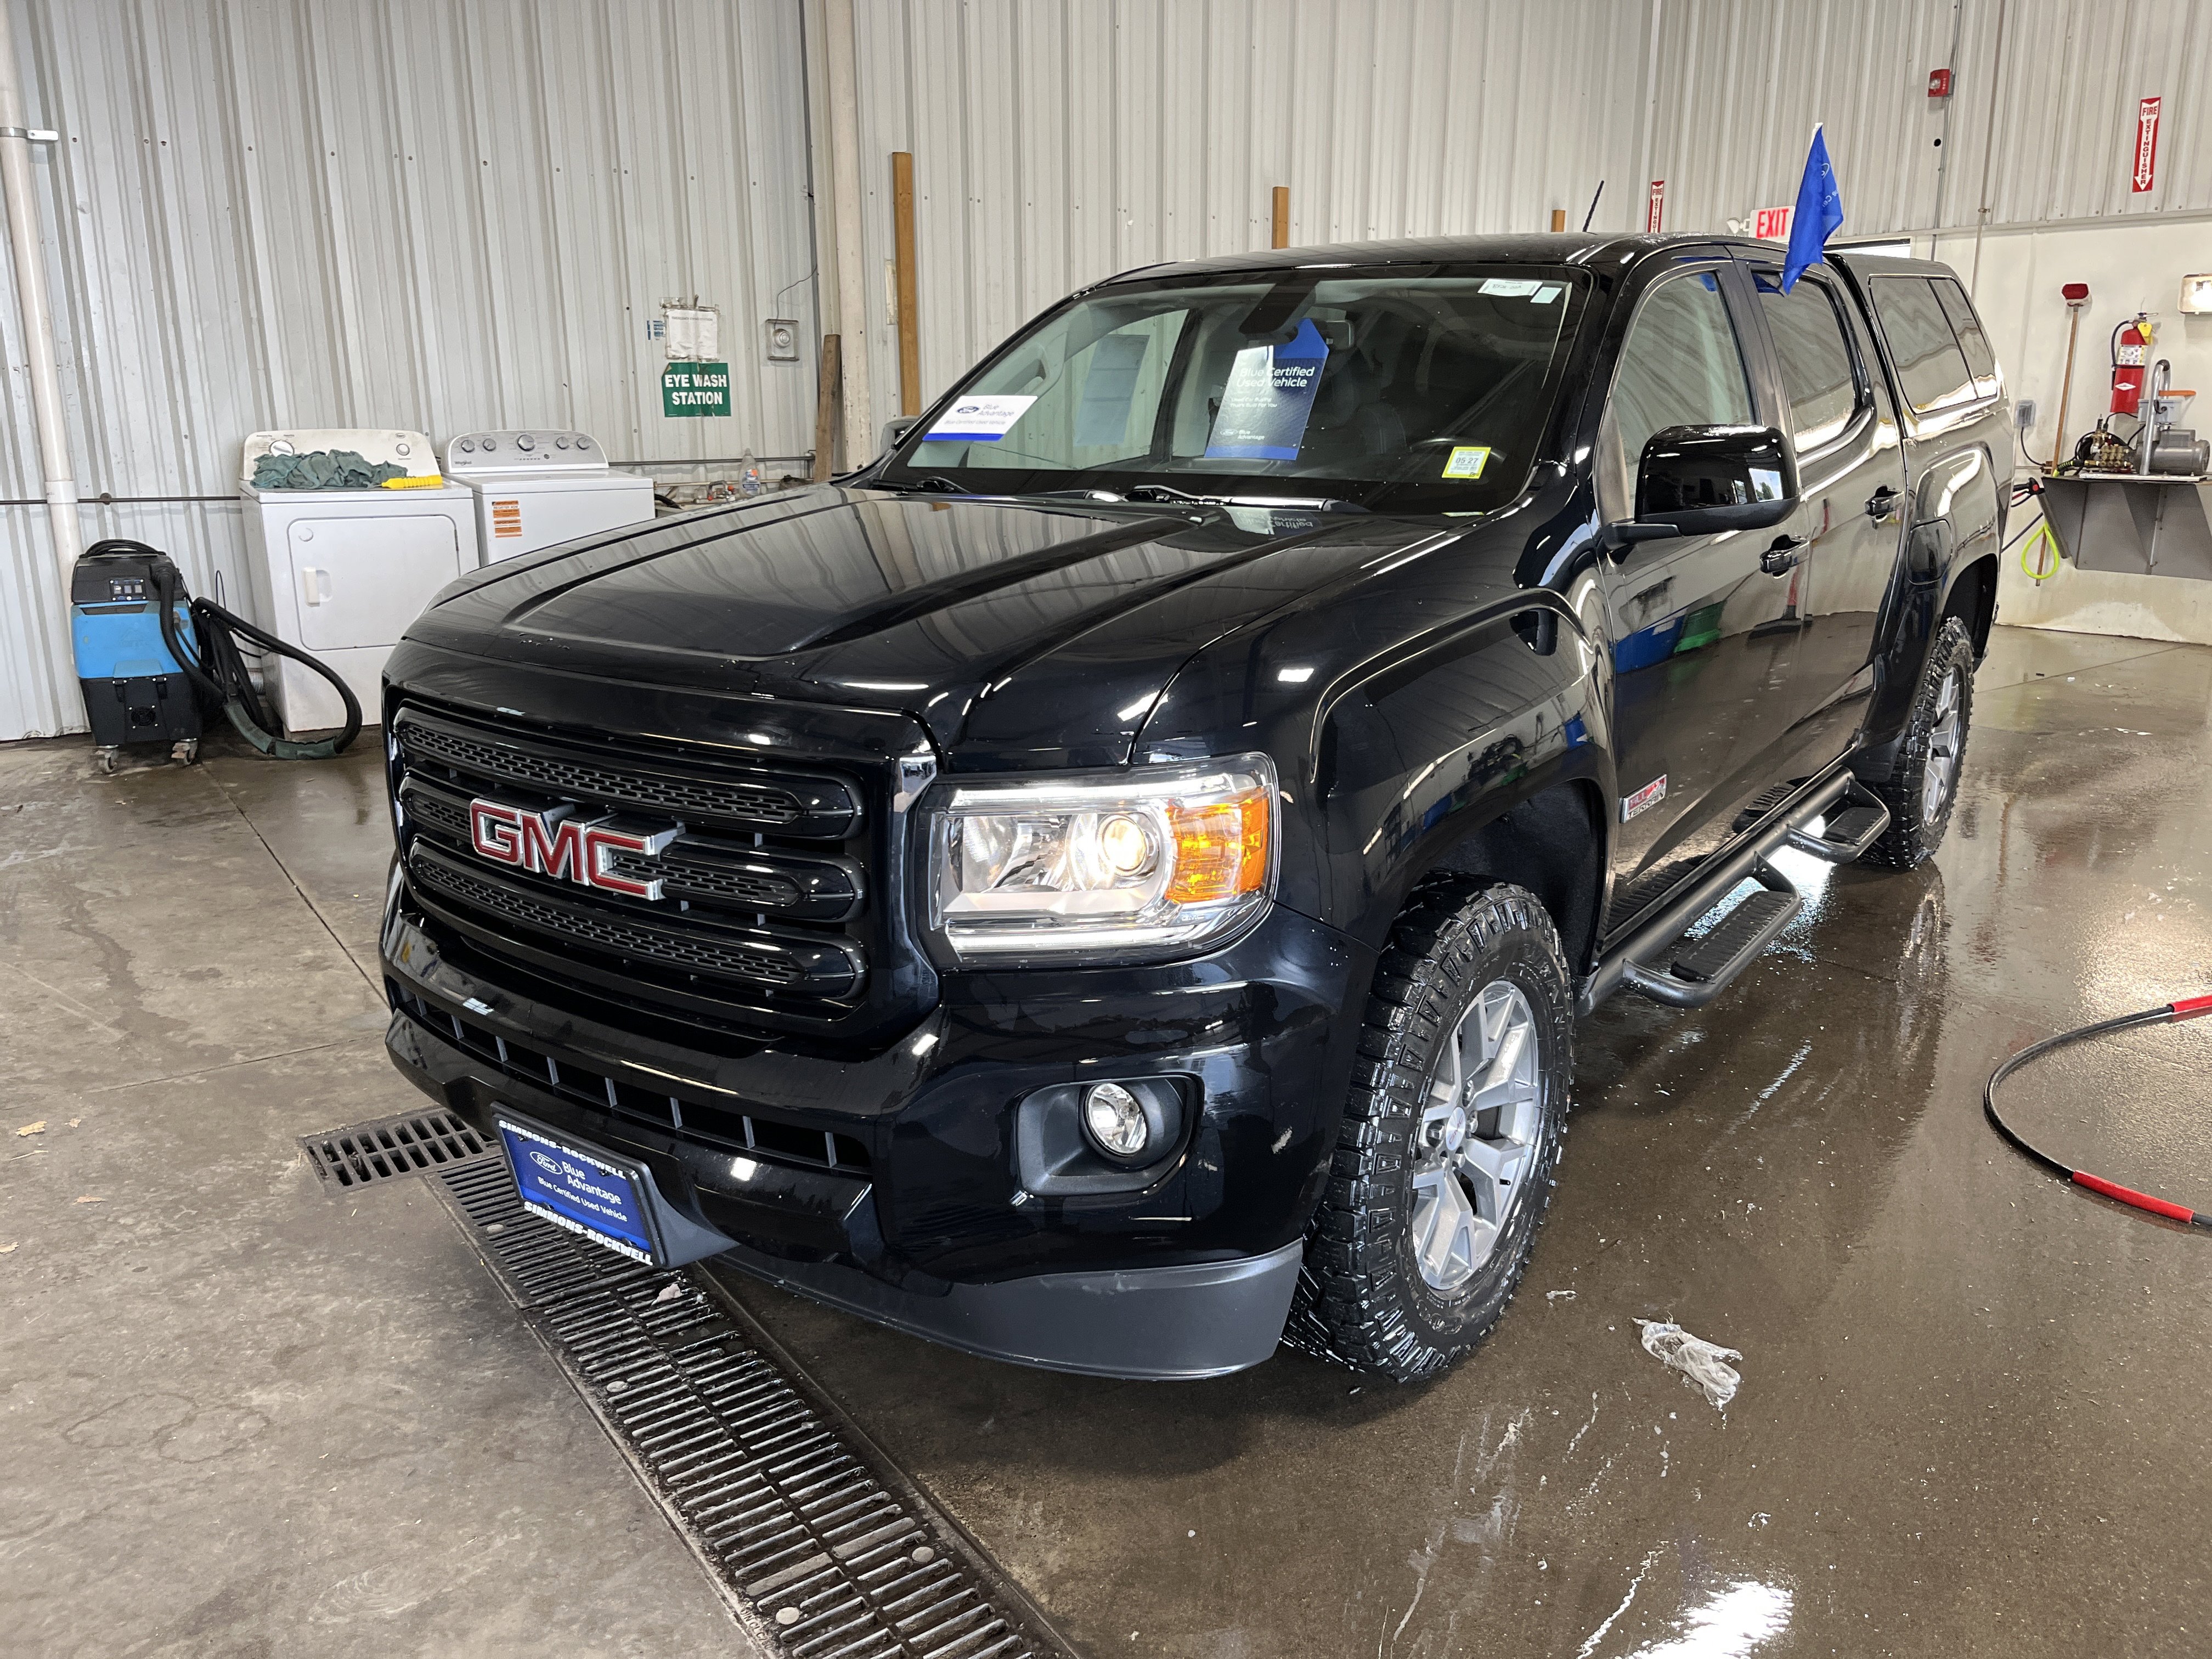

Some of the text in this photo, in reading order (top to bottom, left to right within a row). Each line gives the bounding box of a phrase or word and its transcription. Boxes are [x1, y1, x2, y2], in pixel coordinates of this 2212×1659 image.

[2142, 106, 2158, 116] FIRE
[2140, 119, 2152, 185] EXTINGUISHER
[1756, 208, 1789, 239] EXIT
[665, 374, 727, 387] EYE WASH
[1237, 377, 1307, 387] Used Vehicle
[1240, 366, 1315, 377] Blue Certified
[672, 392, 723, 405] STATION
[470, 798, 662, 901] GMC
[1449, 1113, 1464, 1144] GMC
[499, 1120, 627, 1180] SIMMONS-ROCKWELL
[562, 1161, 585, 1180] Blue
[538, 1176, 628, 1222] Blue Certified Used Vehicle
[567, 1175, 622, 1205] Advantage
[524, 1200, 653, 1266] SIMMONS-ROCKWELL
